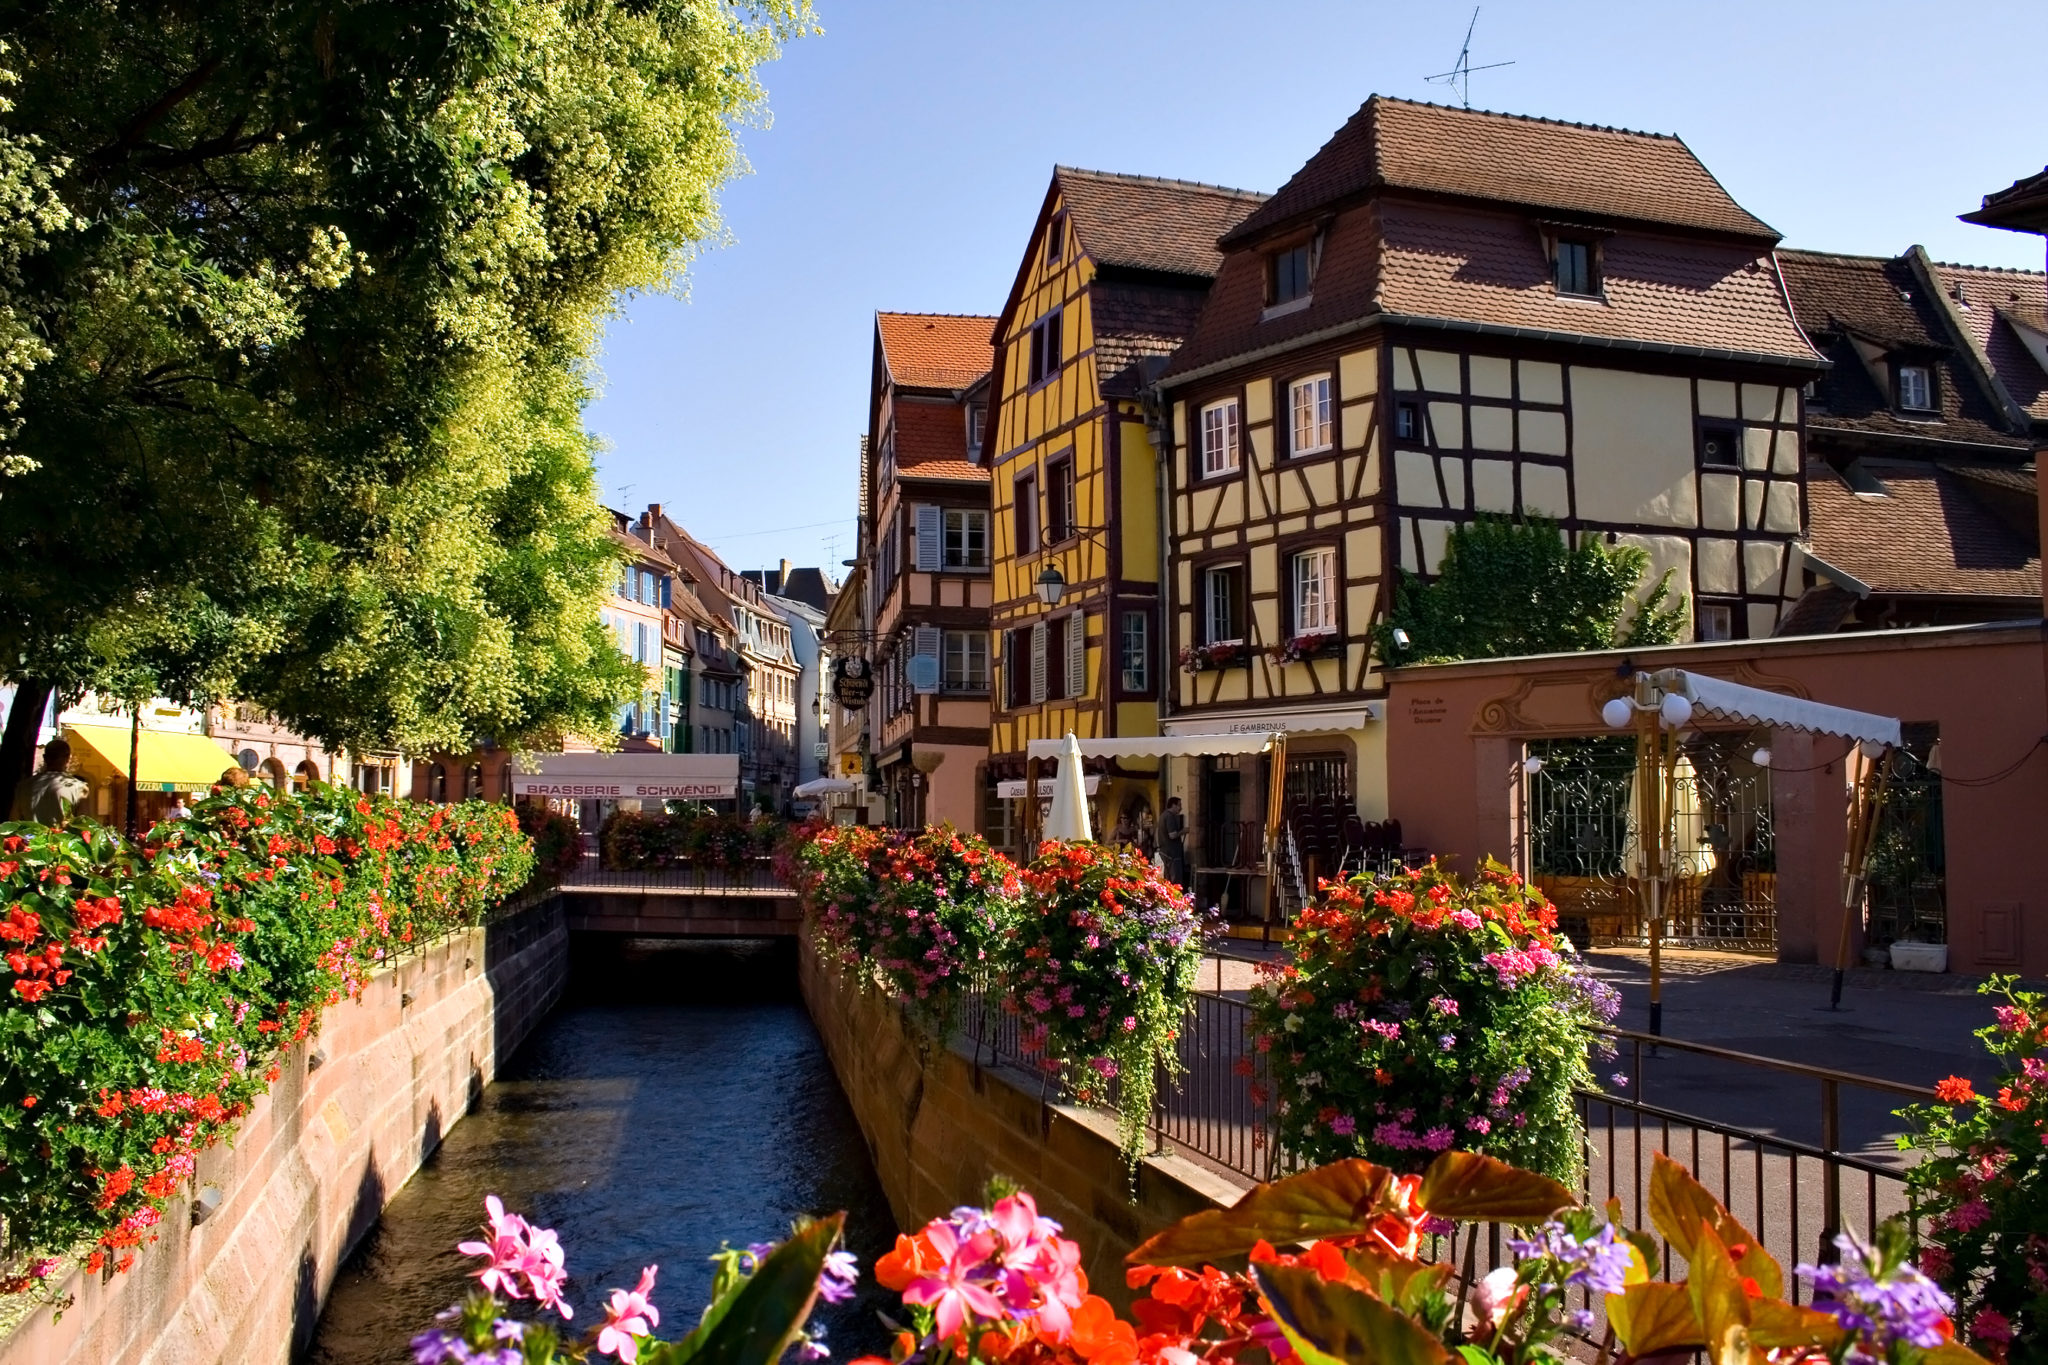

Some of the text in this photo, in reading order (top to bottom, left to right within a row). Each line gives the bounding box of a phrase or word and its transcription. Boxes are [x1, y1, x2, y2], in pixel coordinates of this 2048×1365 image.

[1229, 722, 1286, 732] LE GAMBRINUS
[136, 782, 212, 793] IZZERIA ROMANTIC
[527, 784, 721, 795] BRASSERIE SCHWENDI
